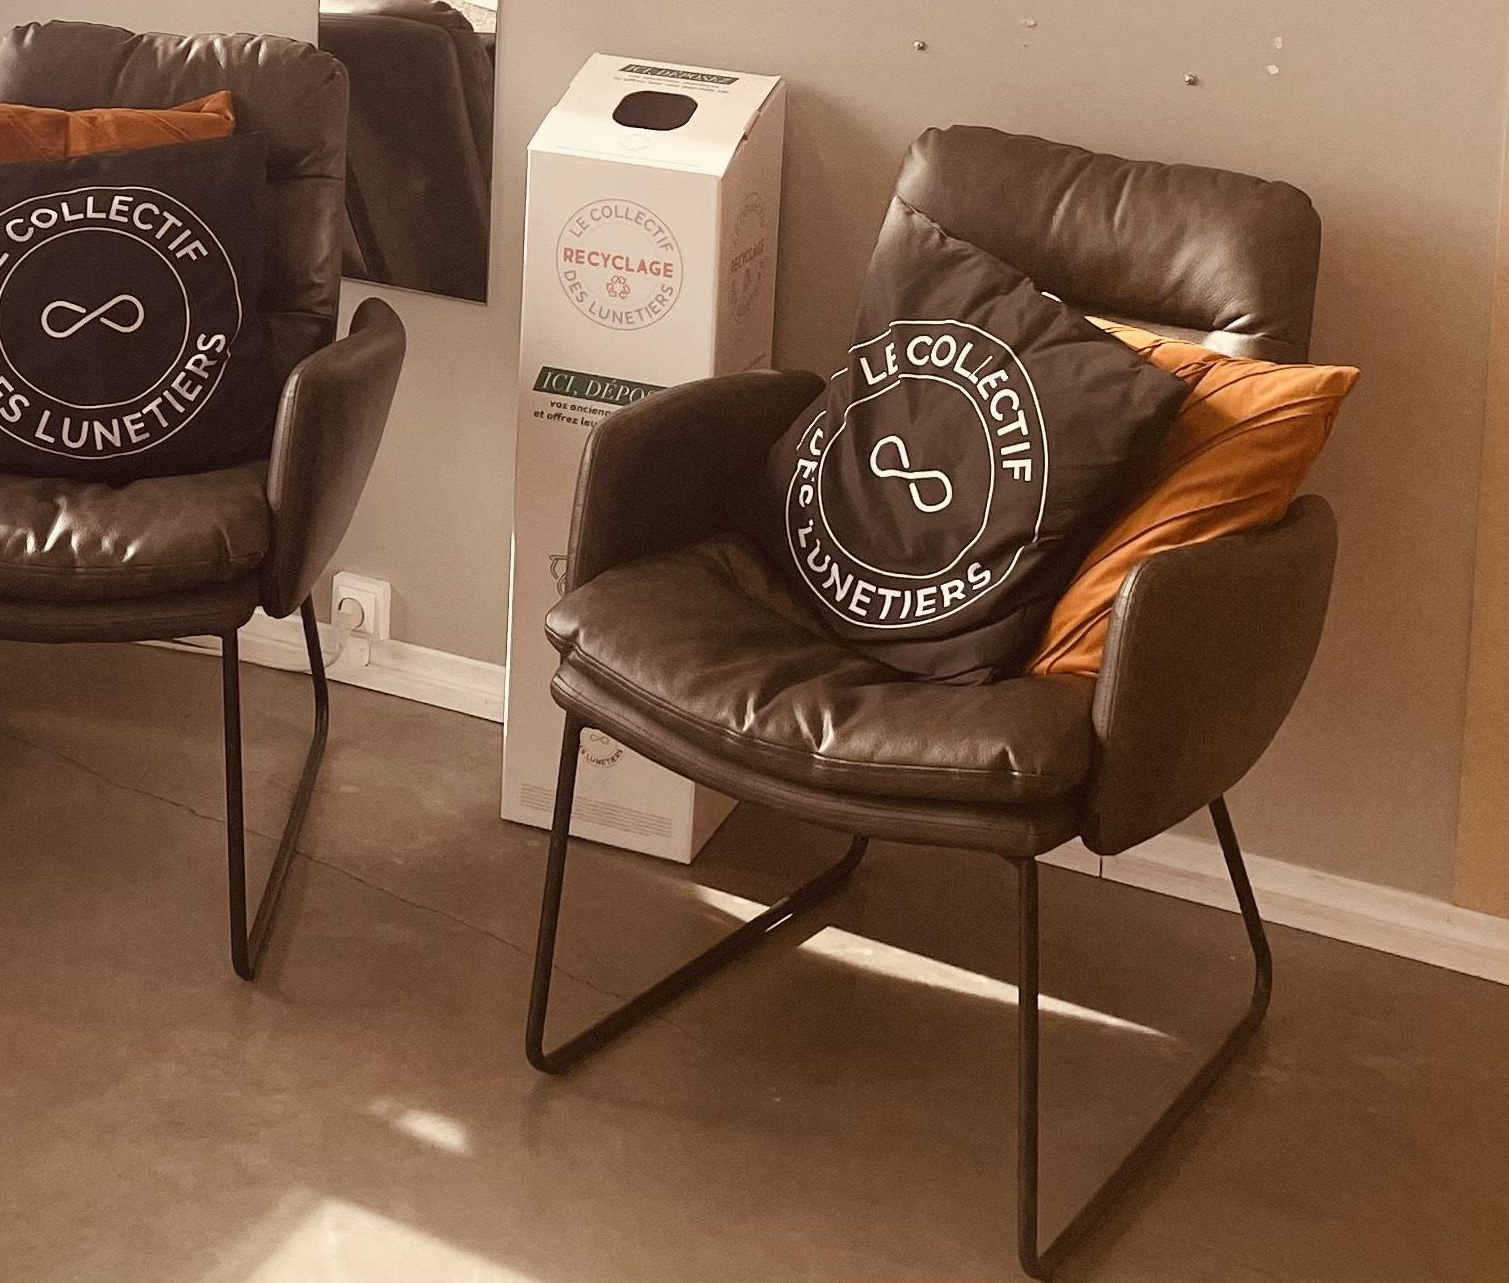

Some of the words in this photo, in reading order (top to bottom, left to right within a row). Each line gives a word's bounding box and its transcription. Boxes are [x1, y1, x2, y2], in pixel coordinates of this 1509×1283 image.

[5, 195, 209, 262] COLLECTIF
[569, 217, 589, 238] LE
[590, 205, 674, 252] COLLECTIF
[563, 247, 674, 278] RECYCLAGE
[564, 269, 588, 304] DES
[588, 284, 674, 324] LUNETIERS
[35, 332, 227, 451] LUNETIERS
[533, 410, 544, 419] et
[547, 412, 578, 425] offrez
[549, 400, 568, 410] vos
[860, 342, 899, 386] LE
[906, 334, 1032, 482] COLLECTIF
[798, 519, 992, 620] LUNETIERS
